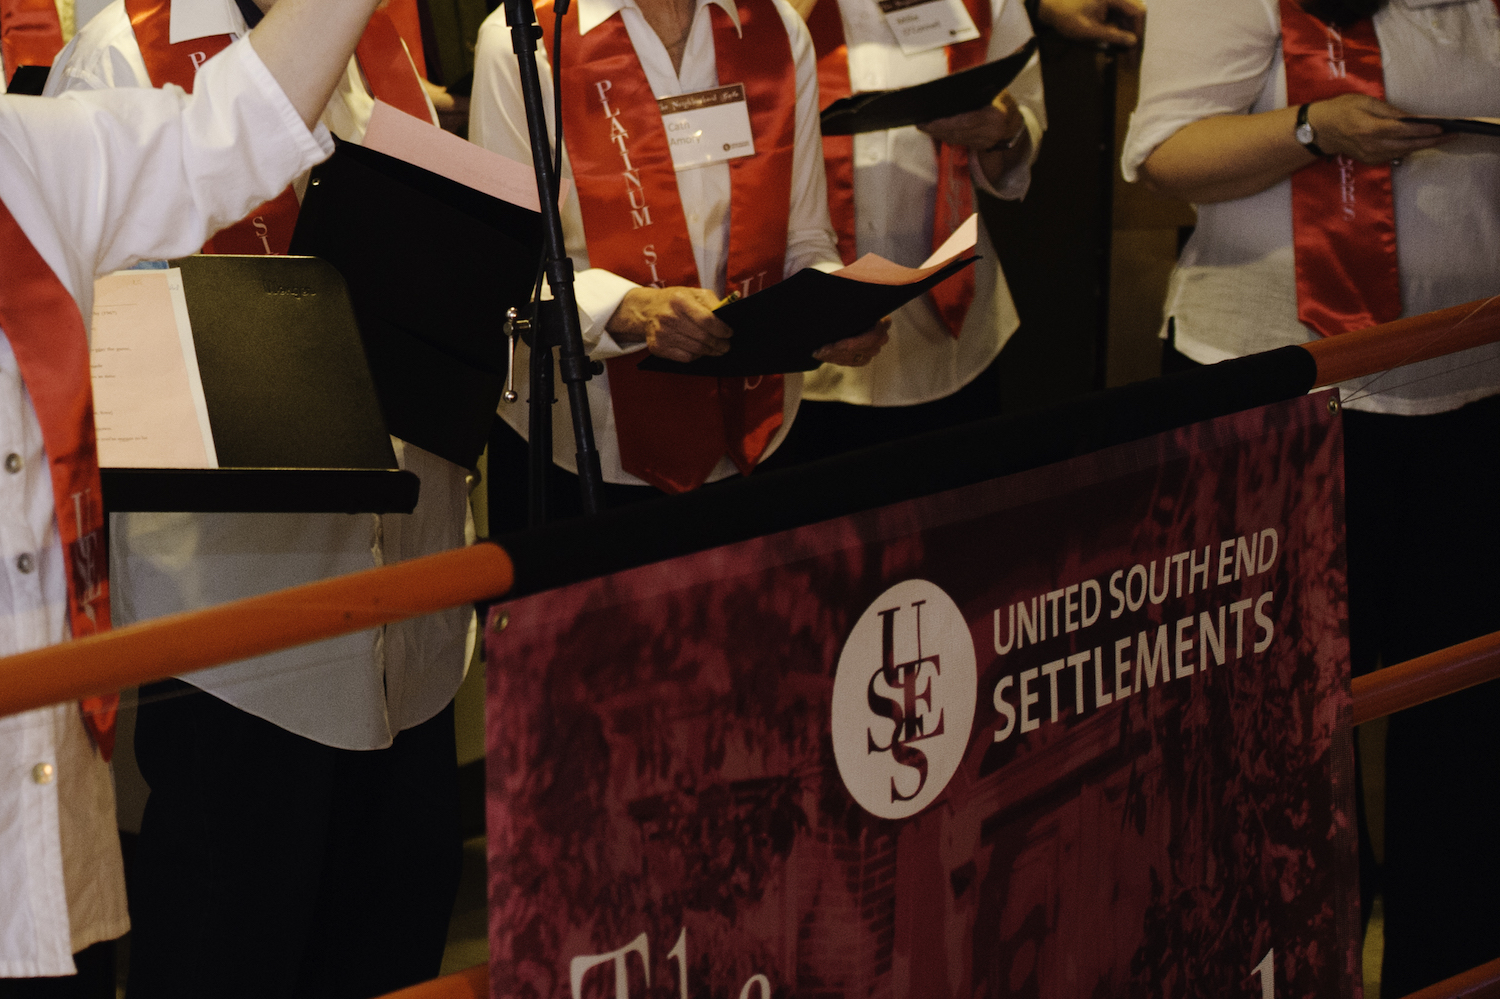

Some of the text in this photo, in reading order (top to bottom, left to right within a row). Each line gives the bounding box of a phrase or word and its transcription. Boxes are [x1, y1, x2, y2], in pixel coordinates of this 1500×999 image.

[595, 79, 653, 230] PLATINUM
[993, 527, 1279, 655] UNITED SOUTH END
[993, 591, 1274, 743] SETTLEMENTS
